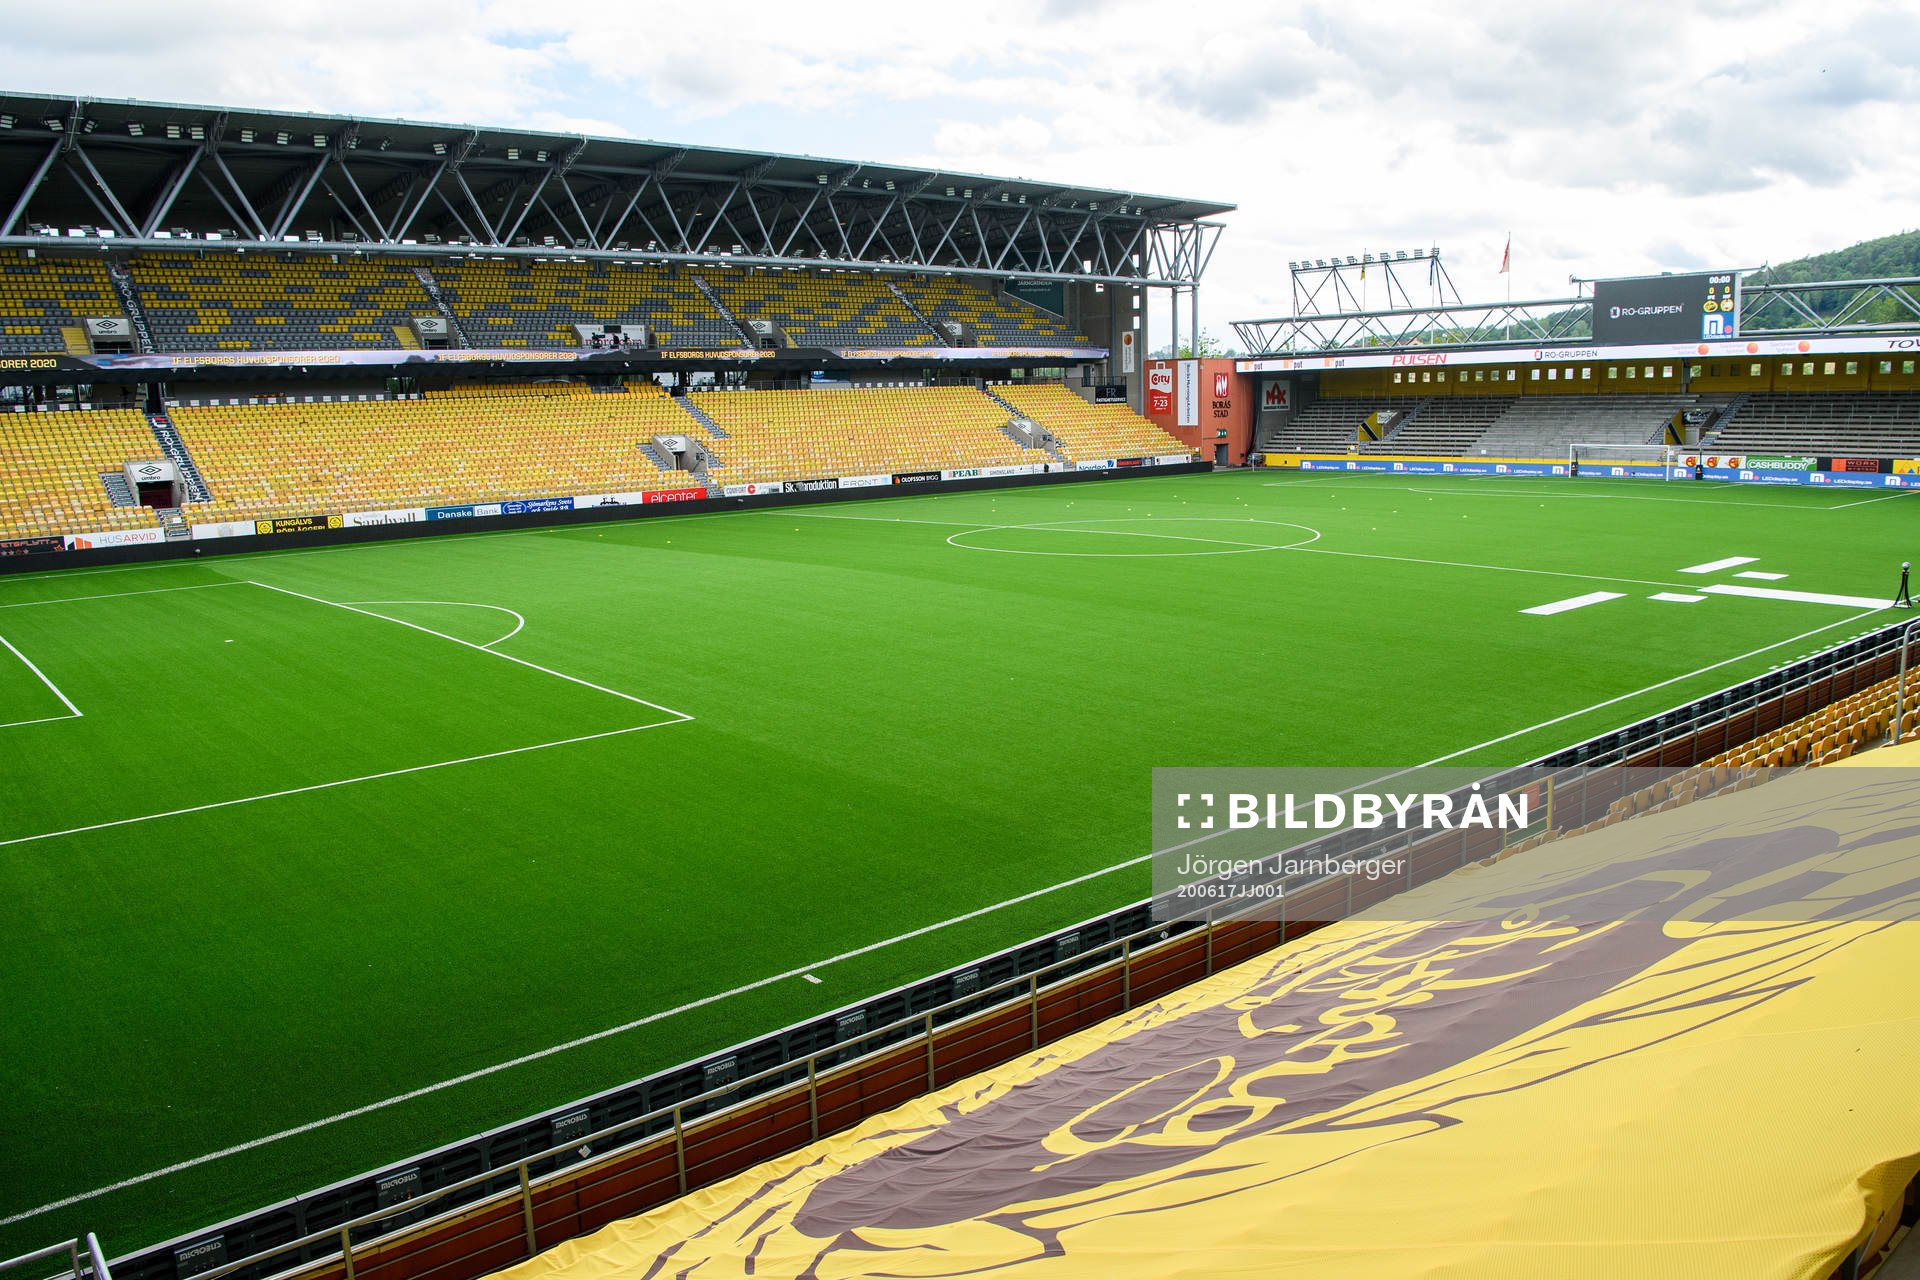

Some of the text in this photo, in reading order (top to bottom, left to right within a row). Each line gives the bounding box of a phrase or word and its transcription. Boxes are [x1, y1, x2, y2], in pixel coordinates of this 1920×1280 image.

[1709, 276, 1731, 284] 00:00
[1621, 305, 1682, 316] RO-GRUPPEN
[1392, 353, 1447, 366] PULSEN
[1544, 350, 1598, 359] RO-GRUPPEN
[30, 359, 57, 368] 2020
[1748, 461, 1808, 470] CASHBUDDY
[952, 469, 978, 478] PEAB
[901, 475, 926, 483] OLOFSSON
[650, 491, 698, 503] elcenter
[437, 510, 472, 519] Danske
[476, 507, 499, 515] Bank
[275, 518, 312, 527] KUNGÄLVS
[555, 1111, 588, 1129] MICROBUS
[381, 1173, 418, 1191] MICROBUS
[180, 1241, 222, 1262] MICROBUS
